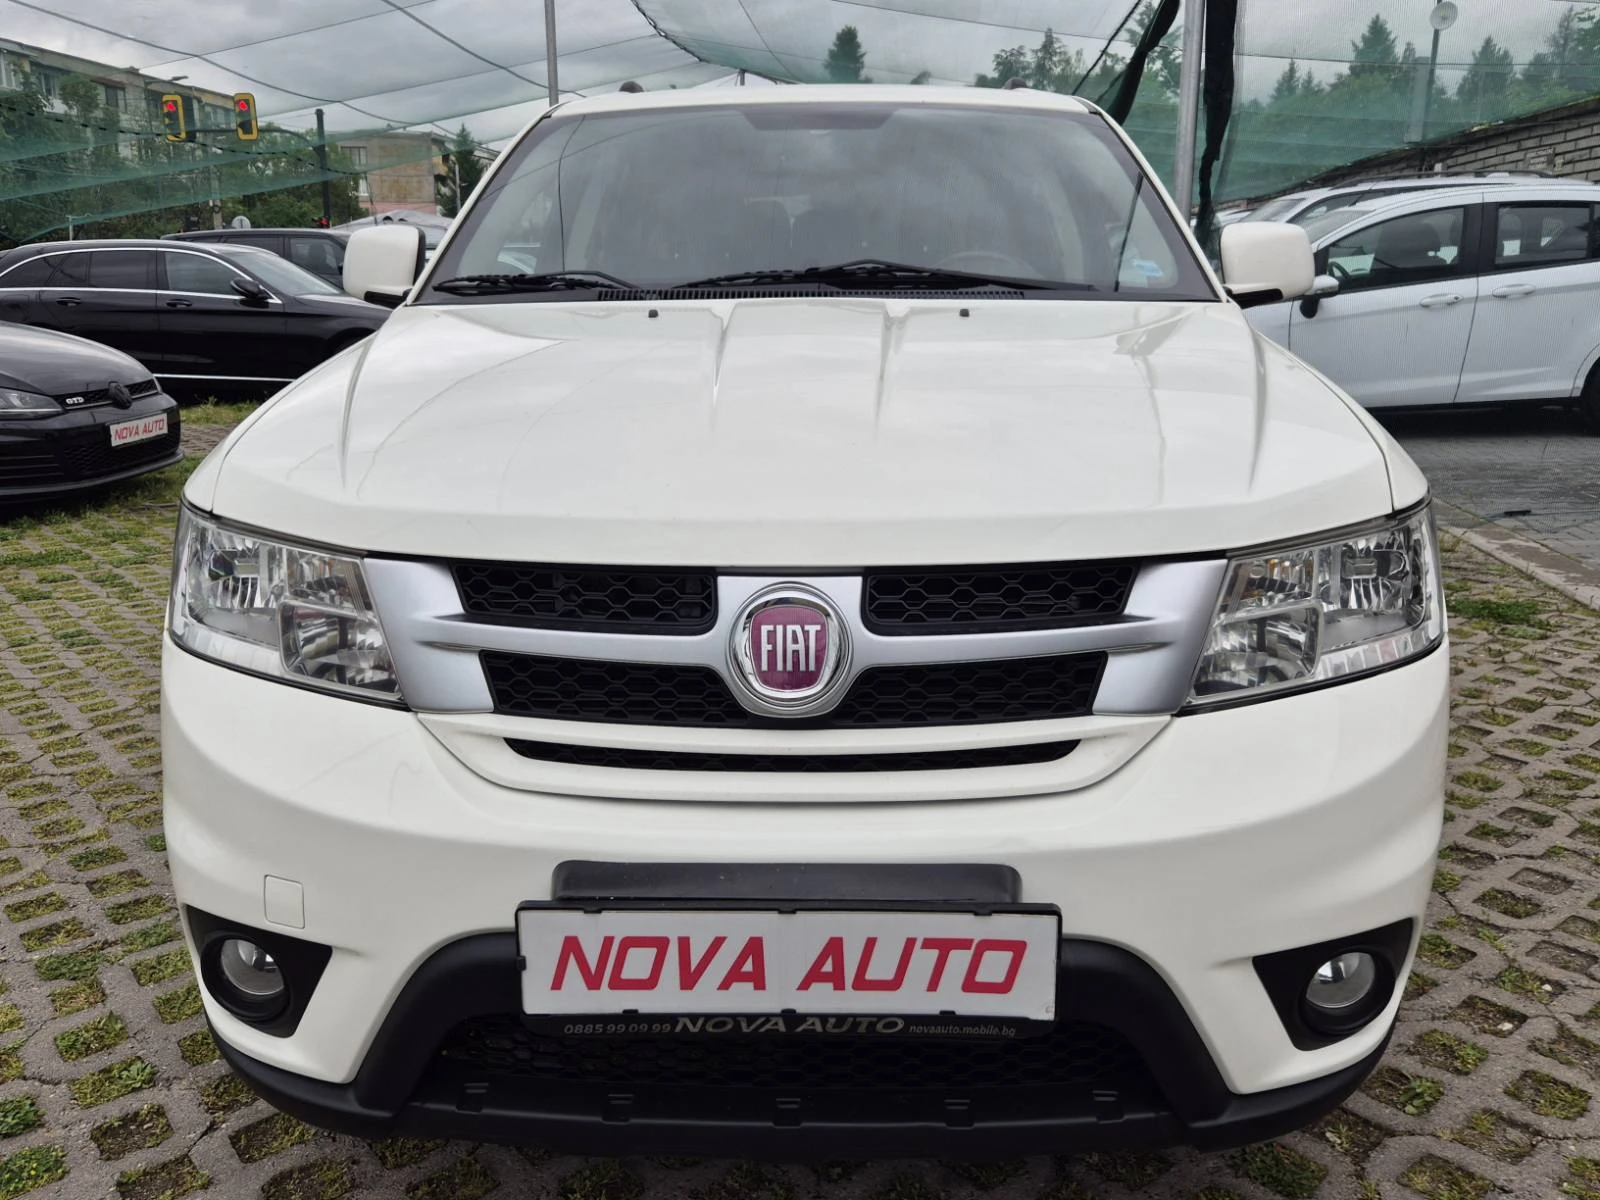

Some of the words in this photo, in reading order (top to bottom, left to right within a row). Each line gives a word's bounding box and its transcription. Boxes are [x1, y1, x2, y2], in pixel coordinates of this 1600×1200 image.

[114, 424, 139, 440] NOVA
[142, 418, 165, 434] AUTO
[760, 624, 821, 672] FIAT
[550, 935, 766, 991] NOVA
[796, 936, 1028, 995] AUTO
[563, 1024, 603, 1035] 0885
[605, 1024, 626, 1034] 99
[628, 1023, 649, 1034] 09
[651, 1023, 672, 1034] 99
[674, 1016, 787, 1033] NOVA
[794, 1016, 905, 1034] AUTO
[909, 1023, 1017, 1038] novaauto.mobile.bg
